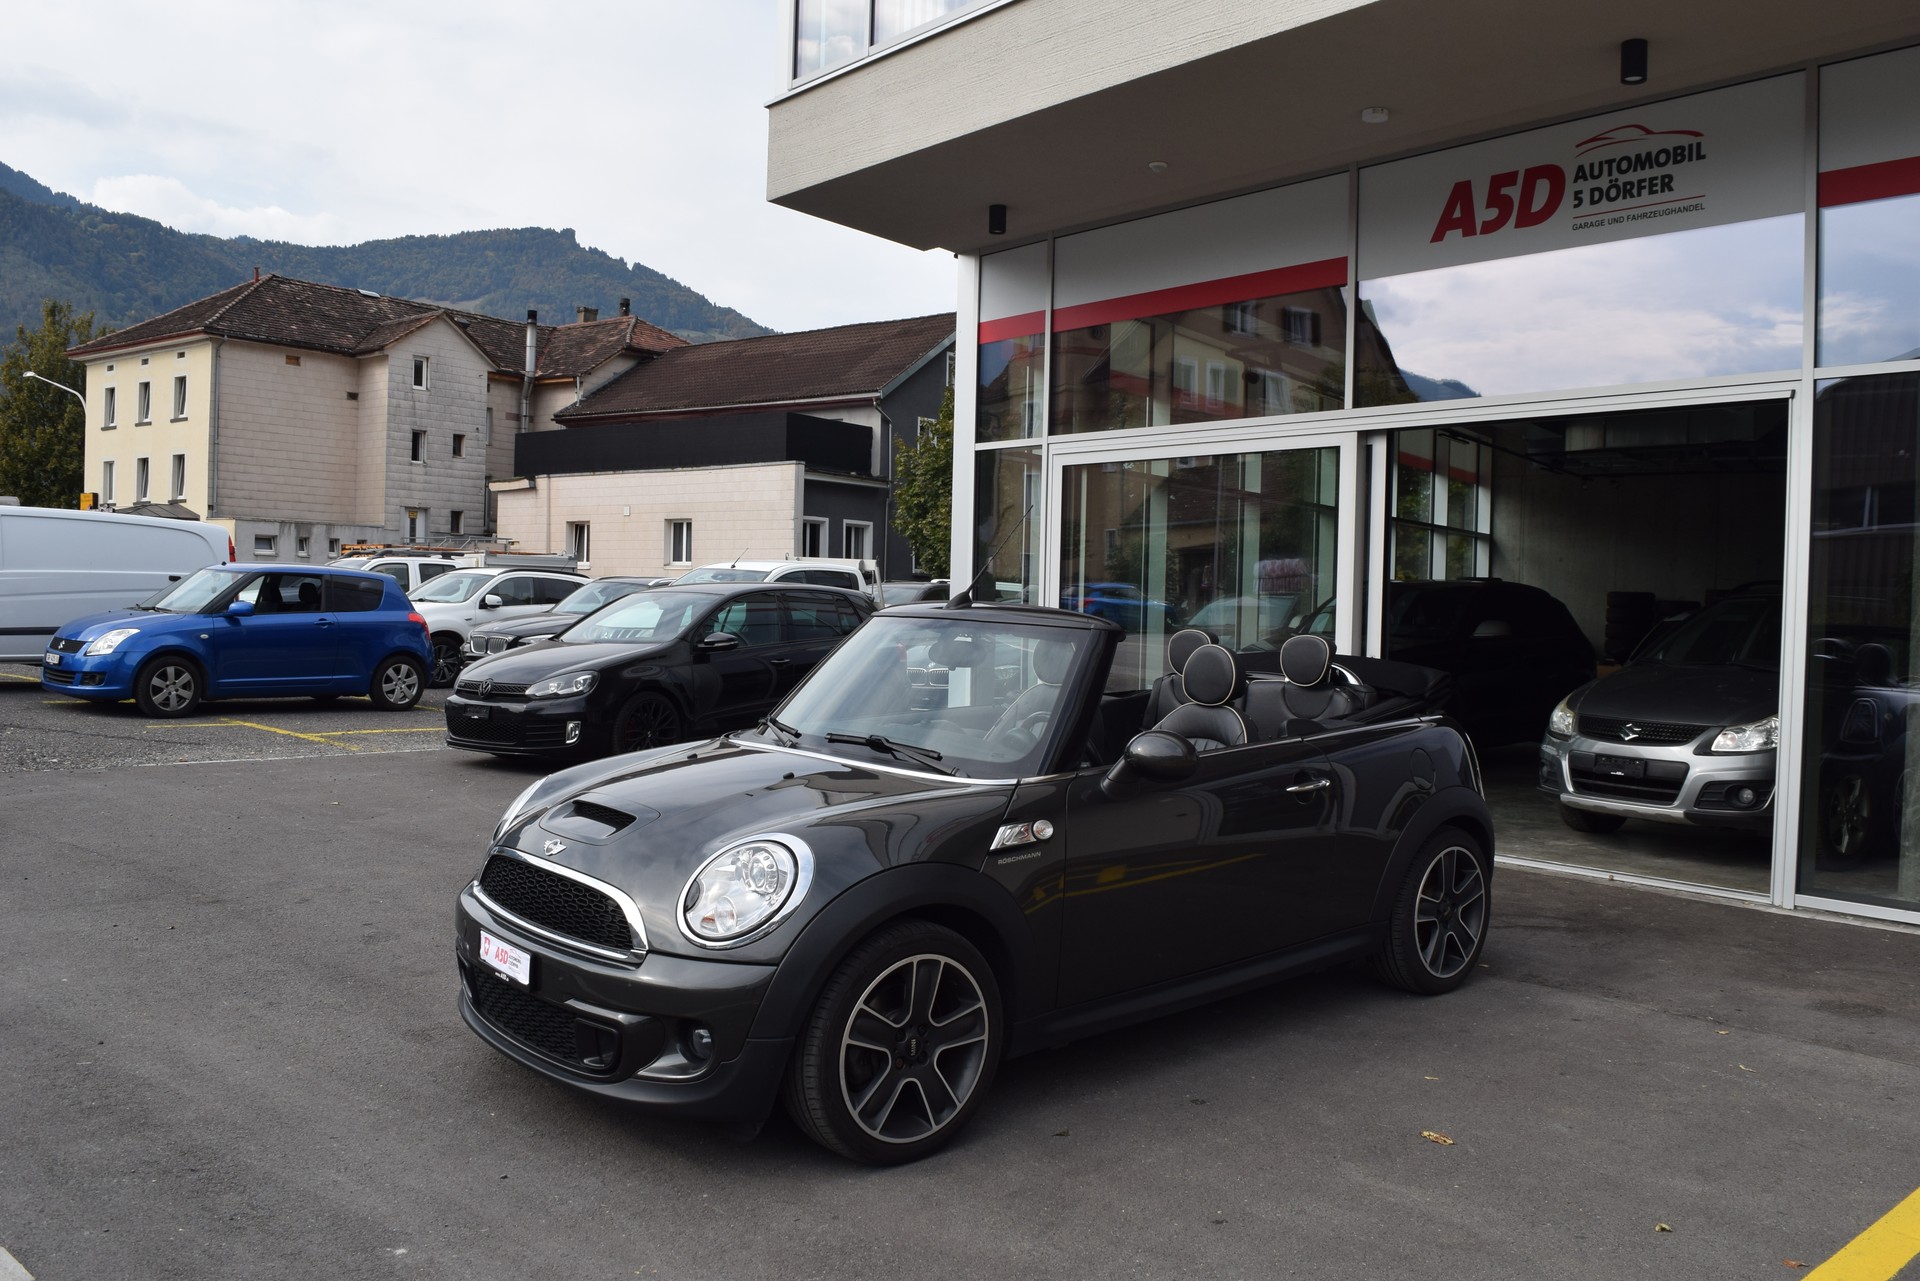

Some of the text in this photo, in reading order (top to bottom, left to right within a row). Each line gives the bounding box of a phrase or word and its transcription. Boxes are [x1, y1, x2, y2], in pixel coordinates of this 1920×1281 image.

[1573, 142, 1706, 183] AUTOMOBIL
[1429, 164, 1566, 243] A5D
[1573, 174, 1674, 208] 5 DÖRFER
[1572, 203, 1706, 231] GARAGE UND FAHRZEUGHANDEL
[495, 946, 509, 965] A5D
